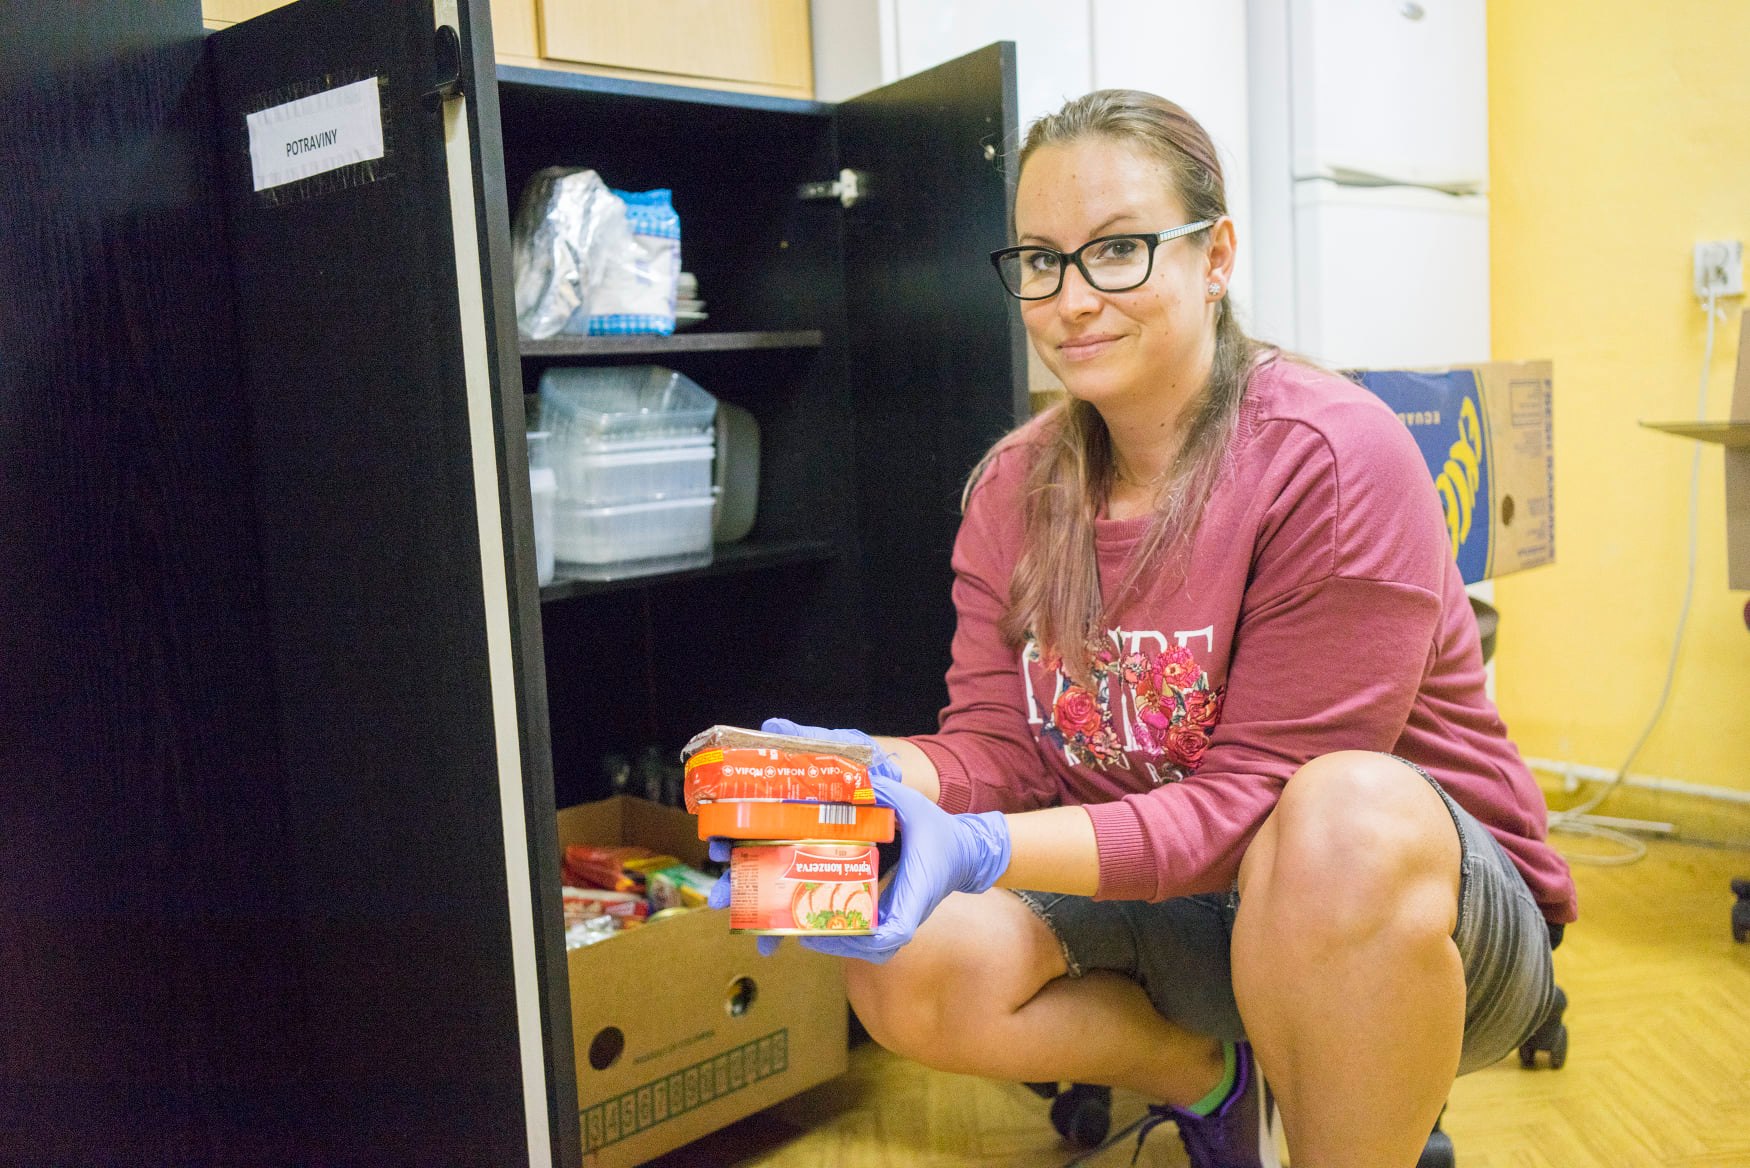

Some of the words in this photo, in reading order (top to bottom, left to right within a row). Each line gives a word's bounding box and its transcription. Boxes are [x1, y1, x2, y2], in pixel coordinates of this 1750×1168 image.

[286, 129, 337, 157] POTRAVINY
[777, 767, 805, 777] VIFON
[820, 767, 844, 775] VIFO
[796, 862, 843, 875] konzerva
